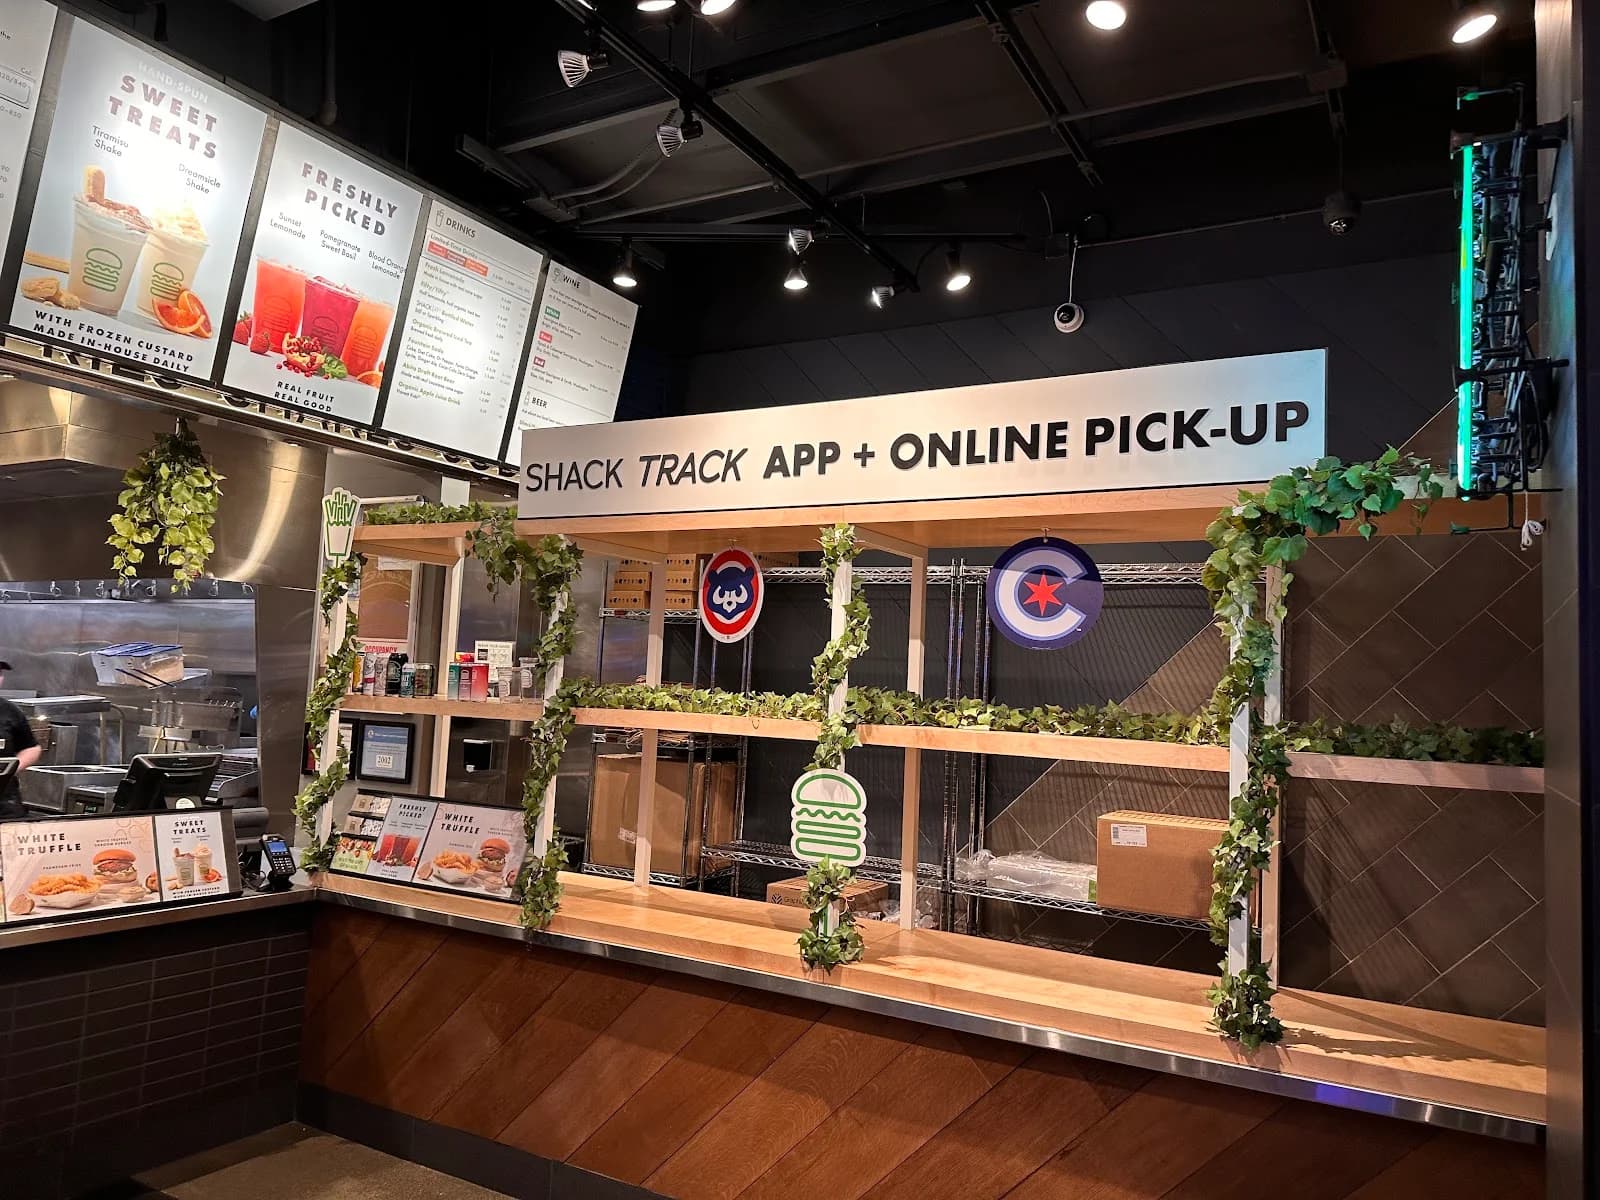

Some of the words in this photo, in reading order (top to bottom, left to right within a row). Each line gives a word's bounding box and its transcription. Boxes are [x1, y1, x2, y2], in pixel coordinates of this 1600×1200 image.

[121, 75, 217, 132] SWEET
[92, 125, 129, 148] Tiramisu
[109, 96, 217, 159] TREATS
[94, 138, 122, 157] Shake
[178, 163, 221, 188] Dreamsicle
[186, 178, 210, 194] Shake
[302, 162, 397, 218] FRESHLY
[278, 212, 302, 227] Sunset
[304, 188, 386, 236] PICKED
[270, 218, 306, 240] Lemonade
[445, 217, 477, 239] DRINKS
[320, 229, 361, 253] Pomegranate
[321, 240, 341, 255] Sweet
[368, 250, 386, 265] Blood
[371, 261, 401, 280] Lemonade
[563, 274, 581, 289] WINE
[35, 310, 72, 327] WITH
[78, 323, 132, 345] FROZEN
[138, 340, 194, 362] CUSTARD
[33, 323, 75, 341] MADE
[80, 336, 148, 361] IN-HOUSE
[153, 357, 190, 373] DAILY
[274, 391, 299, 404] REAL
[303, 399, 332, 412] GOOD
[277, 381, 302, 394] REAL
[306, 389, 335, 403] FRUIT
[531, 397, 548, 409] BEER
[526, 457, 624, 492] SHACK
[638, 448, 748, 487] TRACK
[763, 441, 841, 479] APP
[853, 443, 876, 468] +
[889, 421, 1069, 471] ONLINE
[1085, 400, 1310, 456] PICK-UP
[174, 820, 204, 828] SWEET
[444, 813, 475, 823] WHITE
[17, 832, 66, 844] WHITE
[173, 827, 207, 835] TREATS
[440, 823, 480, 835] TRUFFLE
[17, 843, 81, 856] TRUFFLE
